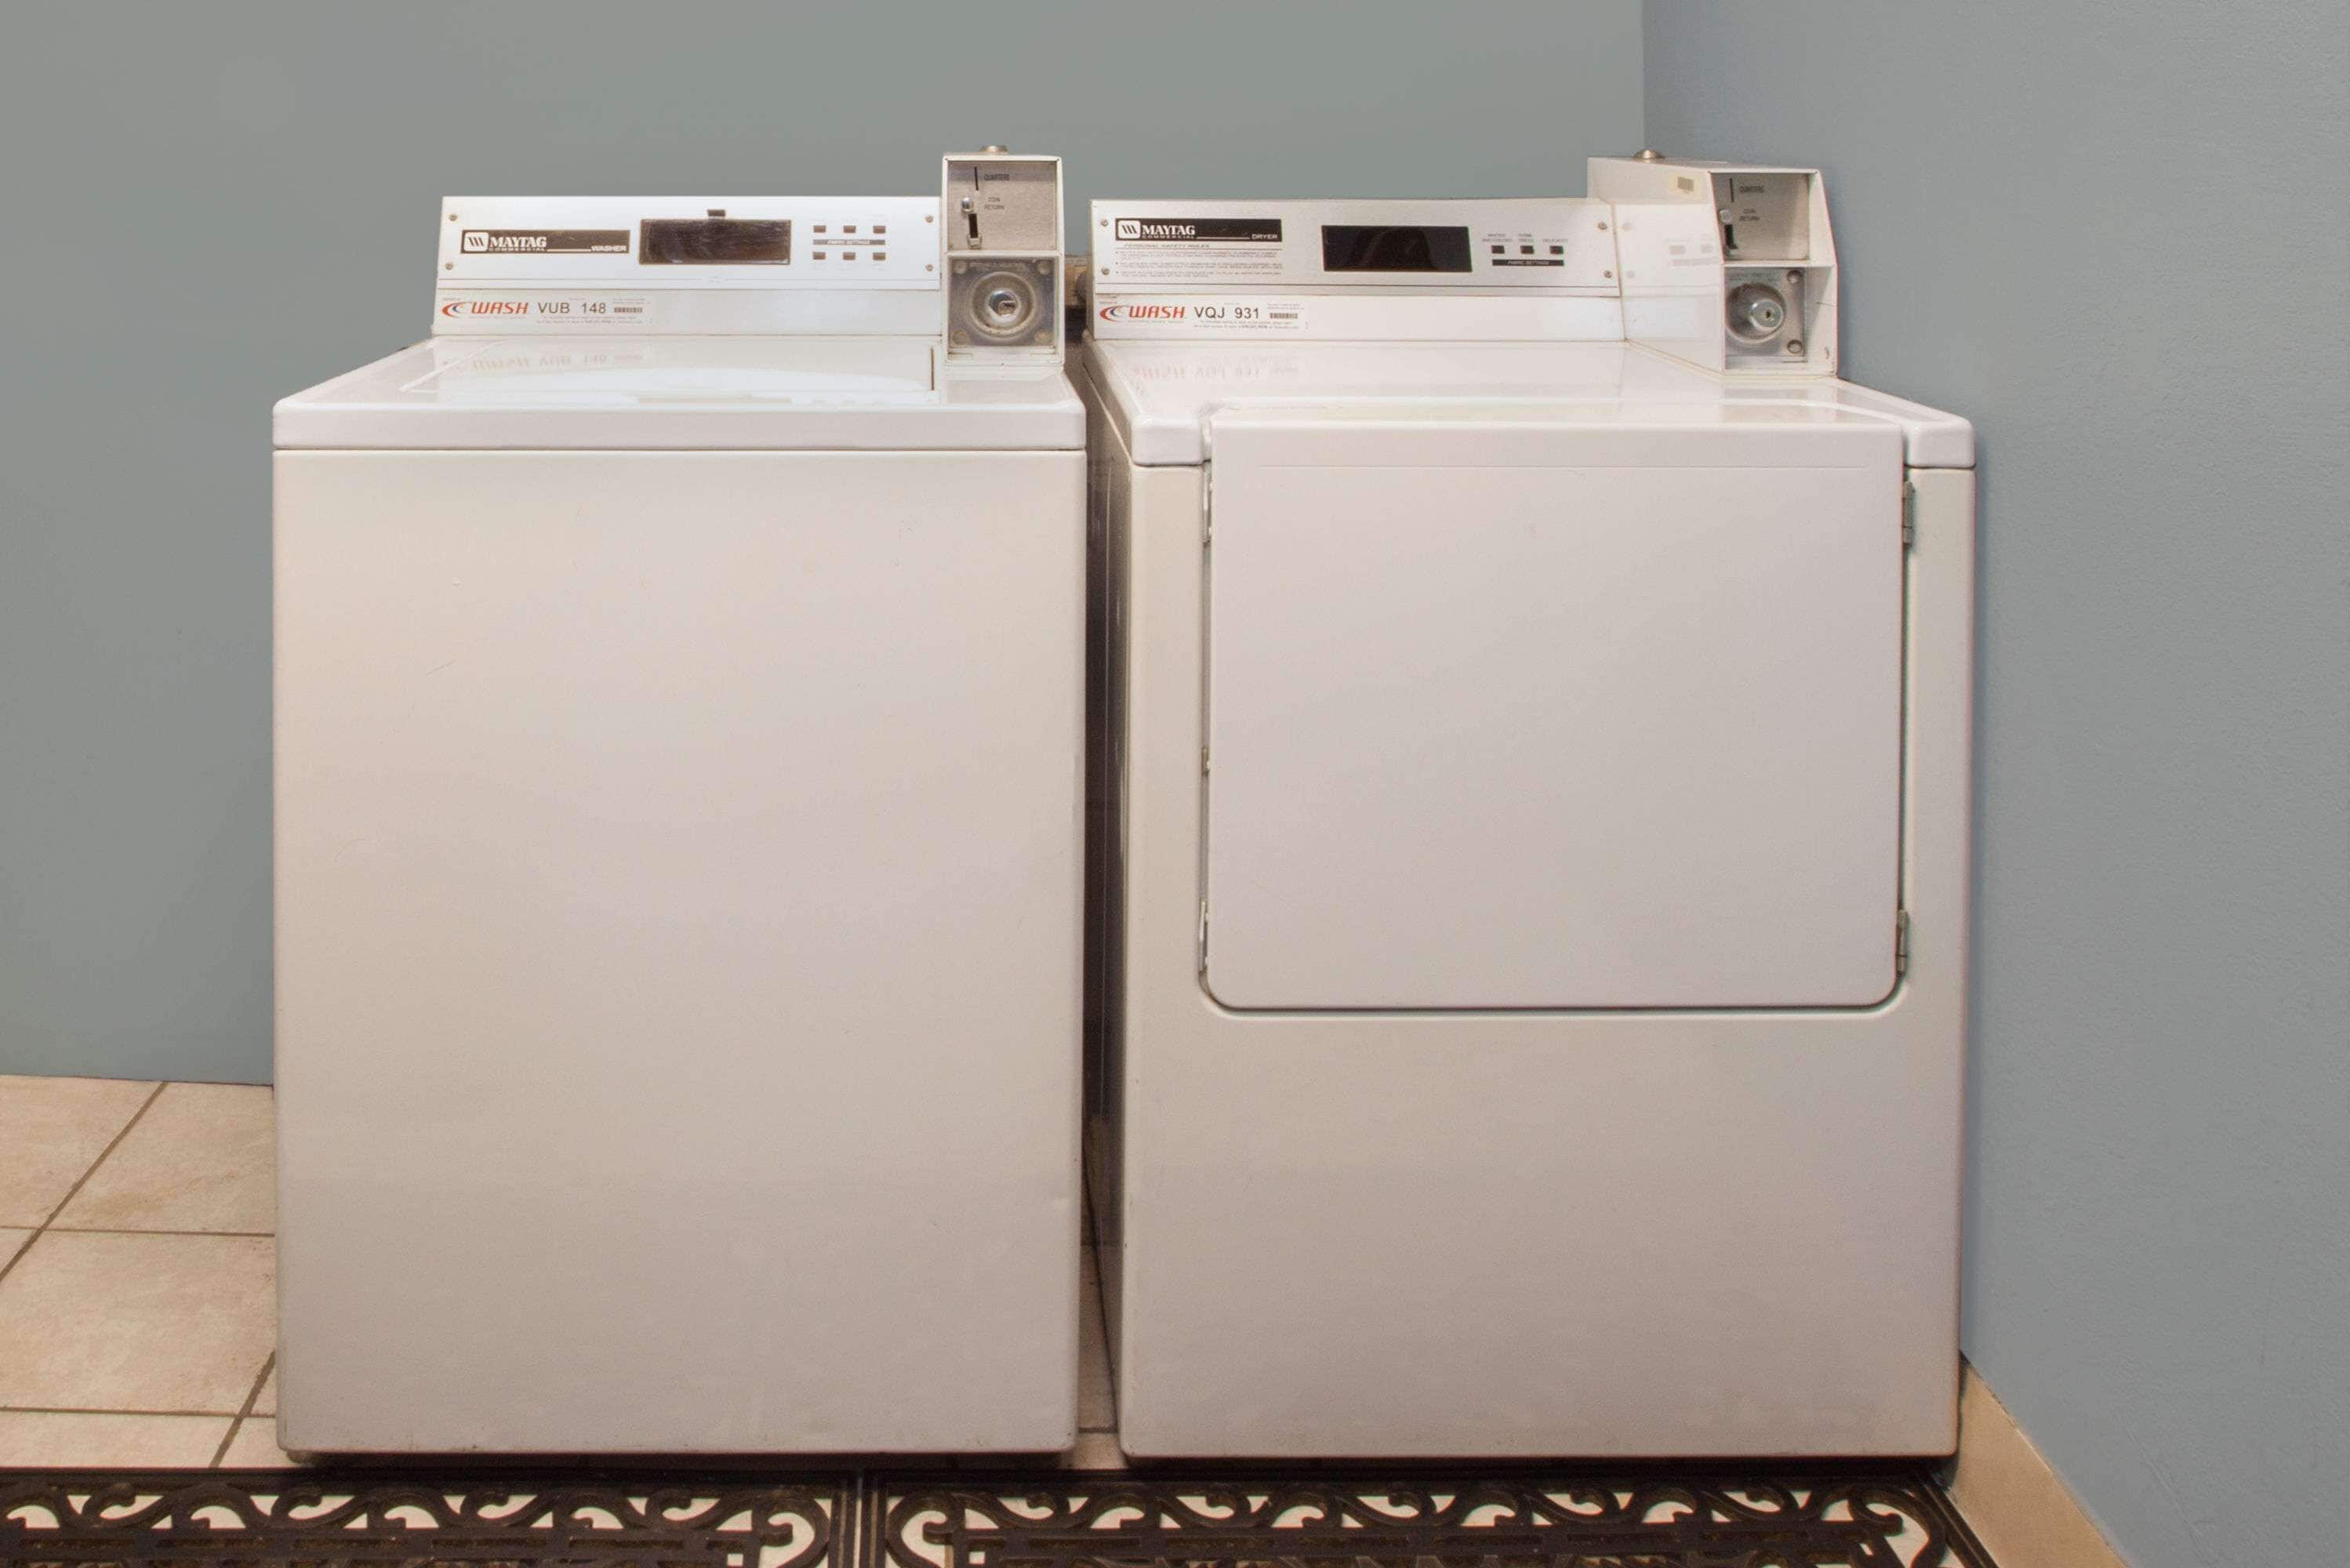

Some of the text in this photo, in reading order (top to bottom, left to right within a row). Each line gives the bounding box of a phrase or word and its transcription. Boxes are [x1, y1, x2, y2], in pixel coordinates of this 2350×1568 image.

[1142, 225, 1196, 235] MAYTAG
[489, 236, 547, 248] MAYTAG
[470, 301, 528, 314] WASH
[537, 302, 606, 314] VUB 148
[1129, 306, 1186, 318] WASH
[1193, 307, 1259, 319] VQJ 931
